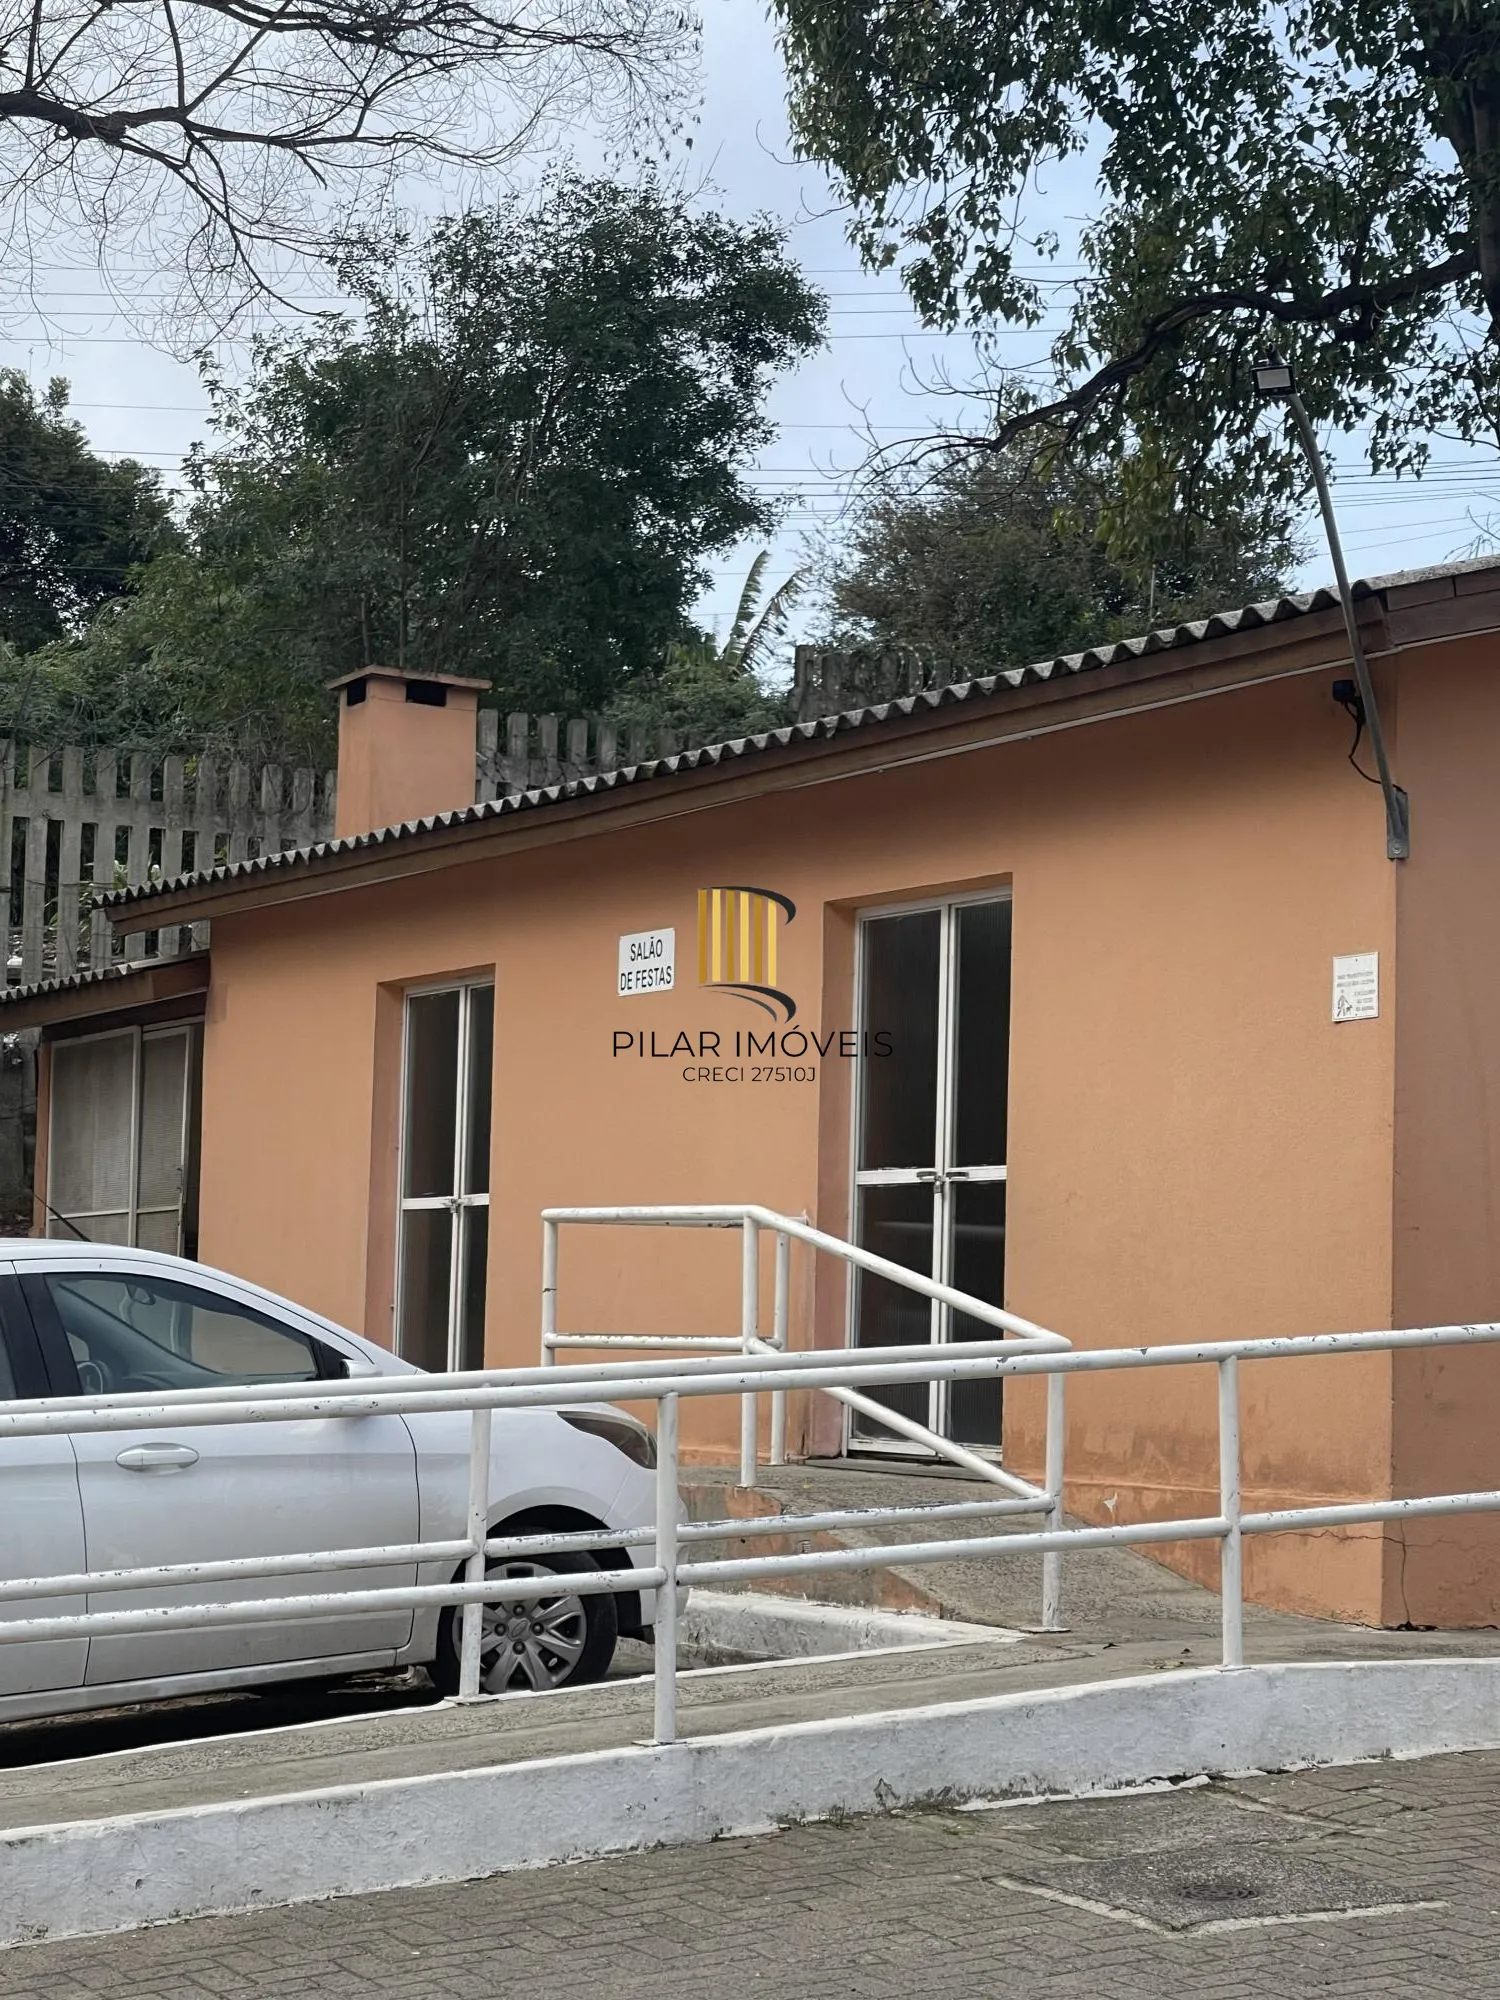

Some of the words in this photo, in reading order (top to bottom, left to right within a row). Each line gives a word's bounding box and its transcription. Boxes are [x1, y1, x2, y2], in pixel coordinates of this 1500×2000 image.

[630, 936, 663, 962] SALÃO
[620, 971, 633, 991] DE
[635, 966, 672, 989] FESTAS
